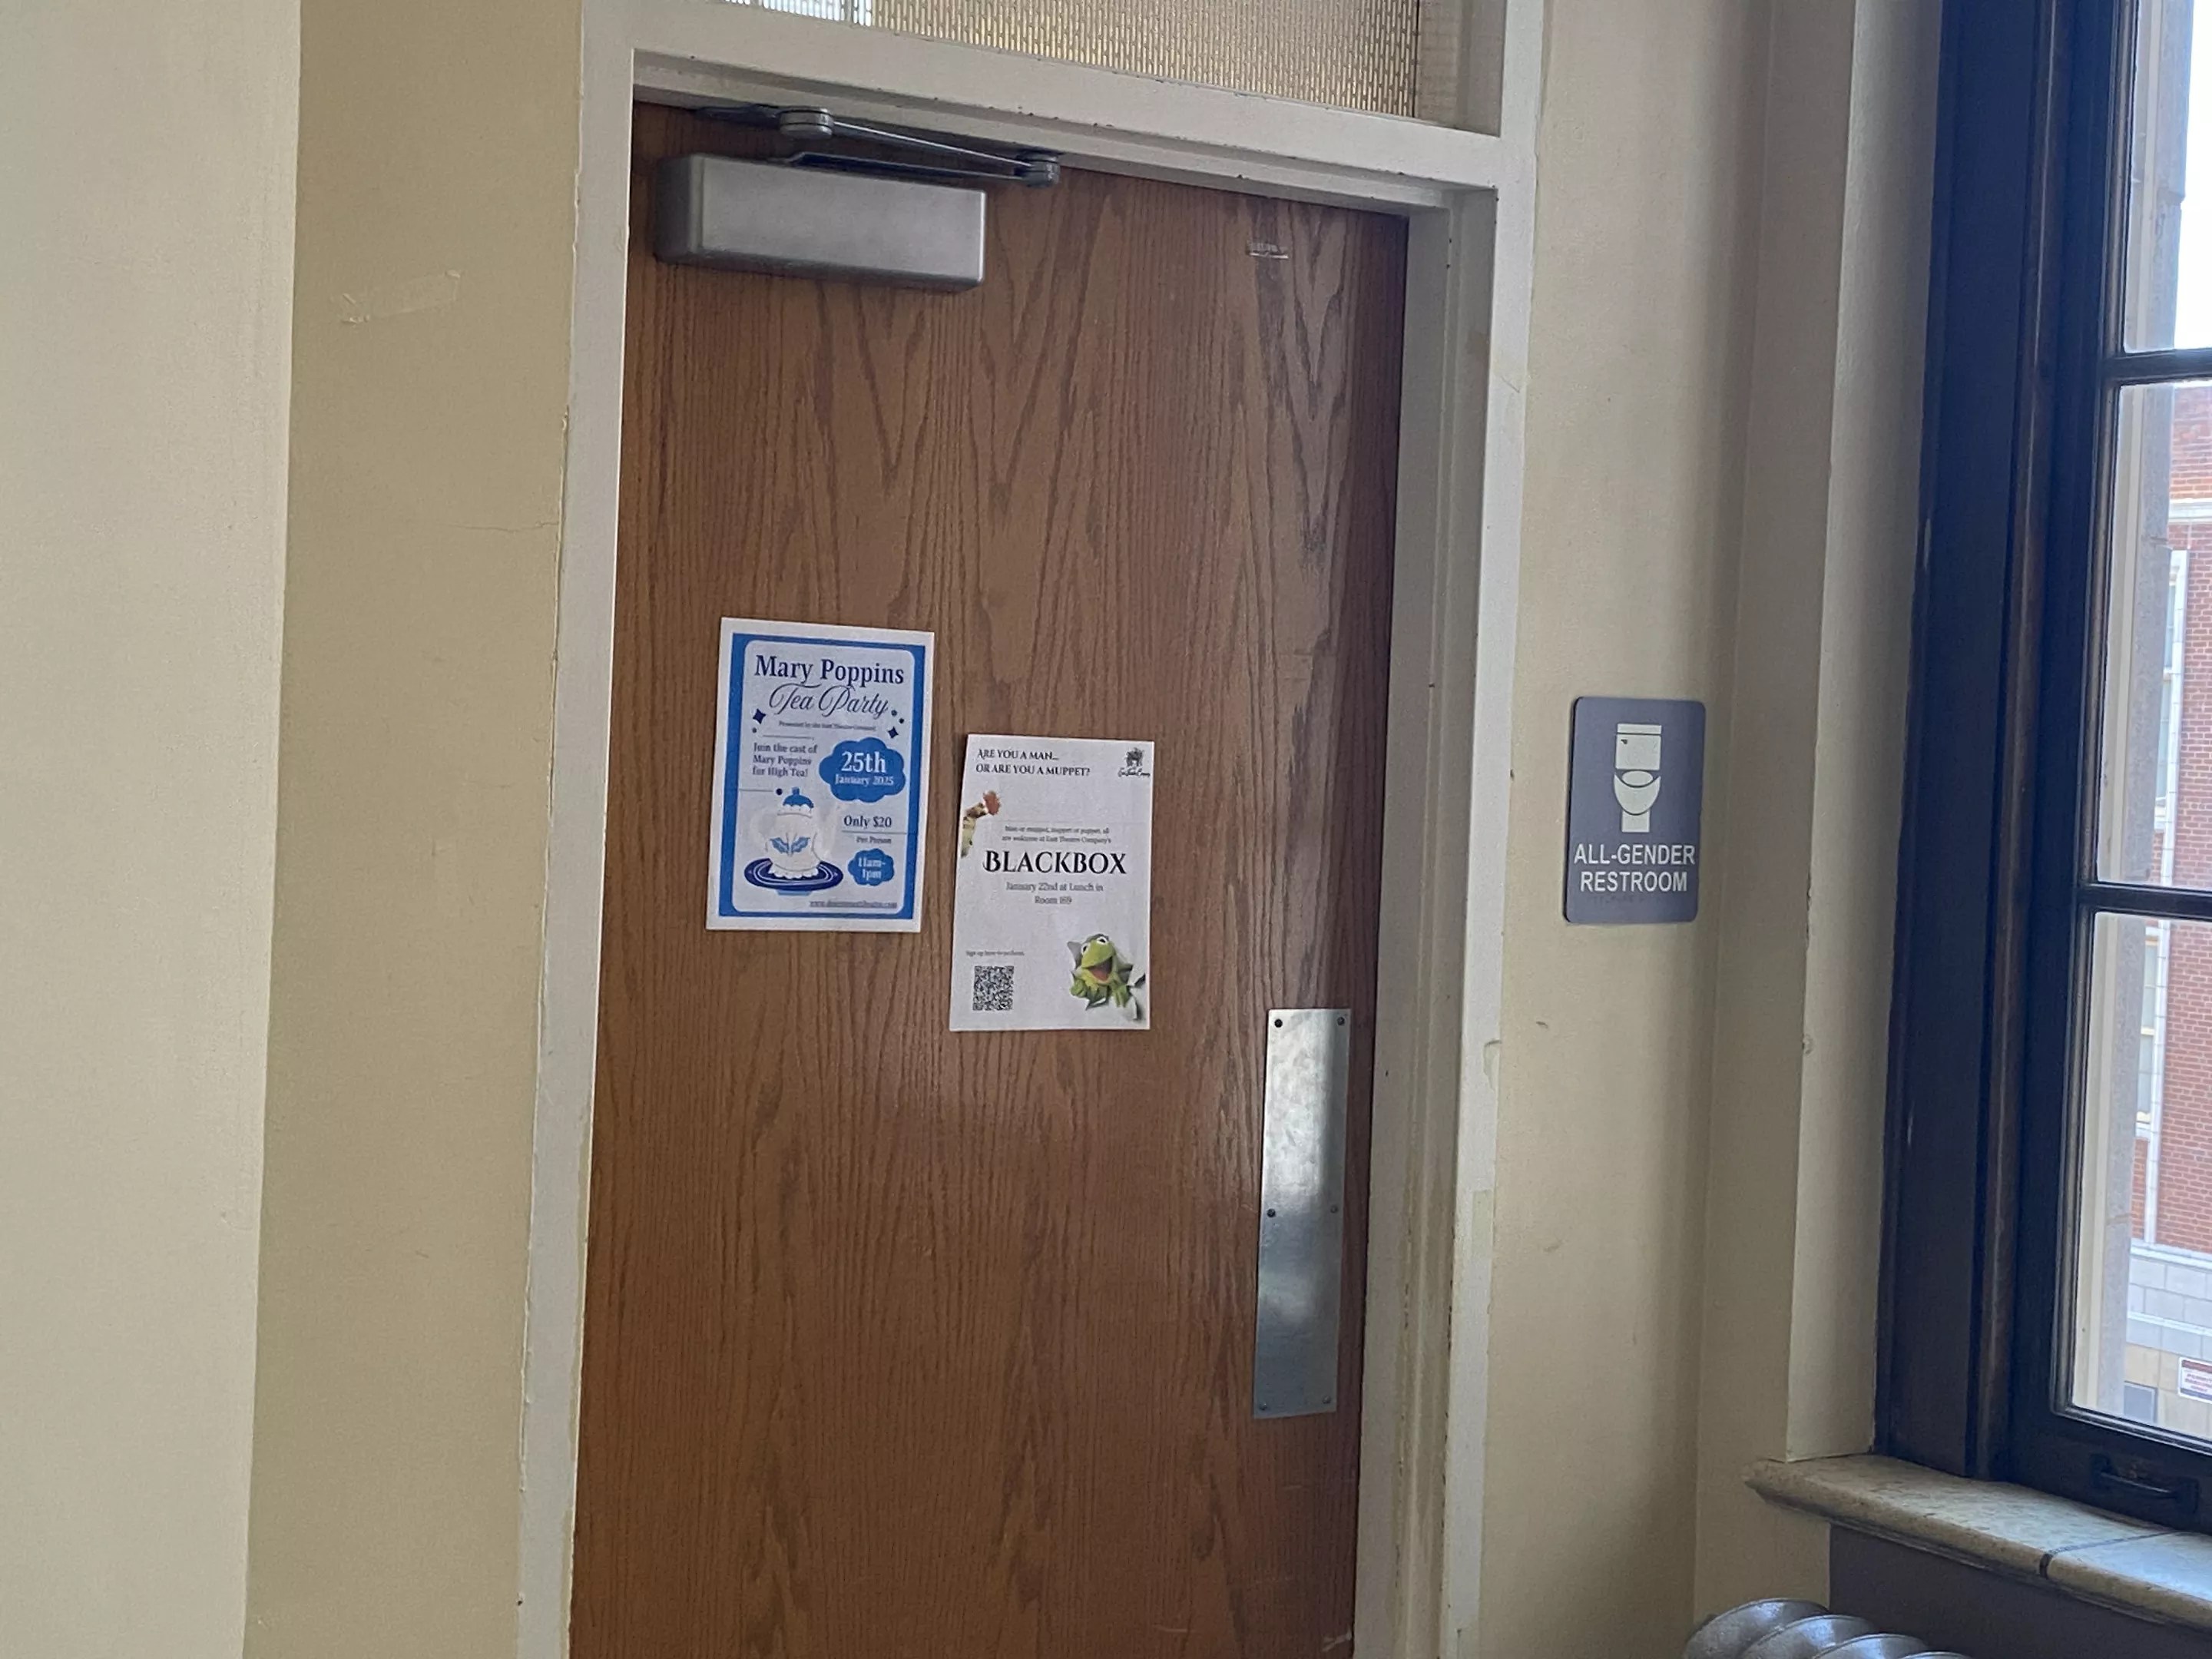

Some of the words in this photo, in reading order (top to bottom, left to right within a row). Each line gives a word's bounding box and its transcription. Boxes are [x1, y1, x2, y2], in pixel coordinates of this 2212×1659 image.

[754, 655, 813, 684] Mary
[820, 659, 904, 687] Poppins
[769, 683, 821, 715] Tea
[818, 684, 889, 720] Party
[753, 743, 771, 753] Join
[773, 743, 788, 753] the
[790, 744, 806, 753] cast
[807, 744, 818, 753] of
[976, 748, 995, 760] ARE
[997, 750, 1019, 760] YOU
[1020, 751, 1028, 760] A
[753, 754, 775, 766] Mary
[777, 756, 812, 767] Poppins
[841, 751, 887, 773] 25th
[753, 765, 767, 776] for
[768, 766, 789, 777] High
[975, 763, 991, 773] OR
[992, 764, 1012, 774] ARE
[1013, 765, 1036, 775] YOU
[1036, 766, 1045, 775] A
[1045, 767, 1091, 777] MUPPET?
[835, 774, 870, 786] January
[873, 776, 894, 785] 2025
[843, 815, 869, 829] Only
[873, 816, 892, 827] $20
[869, 836, 892, 844] Person
[1574, 843, 1695, 865] ALL-GENDER
[982, 850, 1128, 875] BLACKBOX
[862, 869, 882, 881] 1pm
[1580, 871, 1687, 892] RESTROOM
[1005, 882, 1036, 892] January
[1038, 882, 1058, 891] 22nd
[1068, 882, 1094, 892] Lunch
[1095, 883, 1104, 892] in
[1035, 896, 1058, 904] Room
